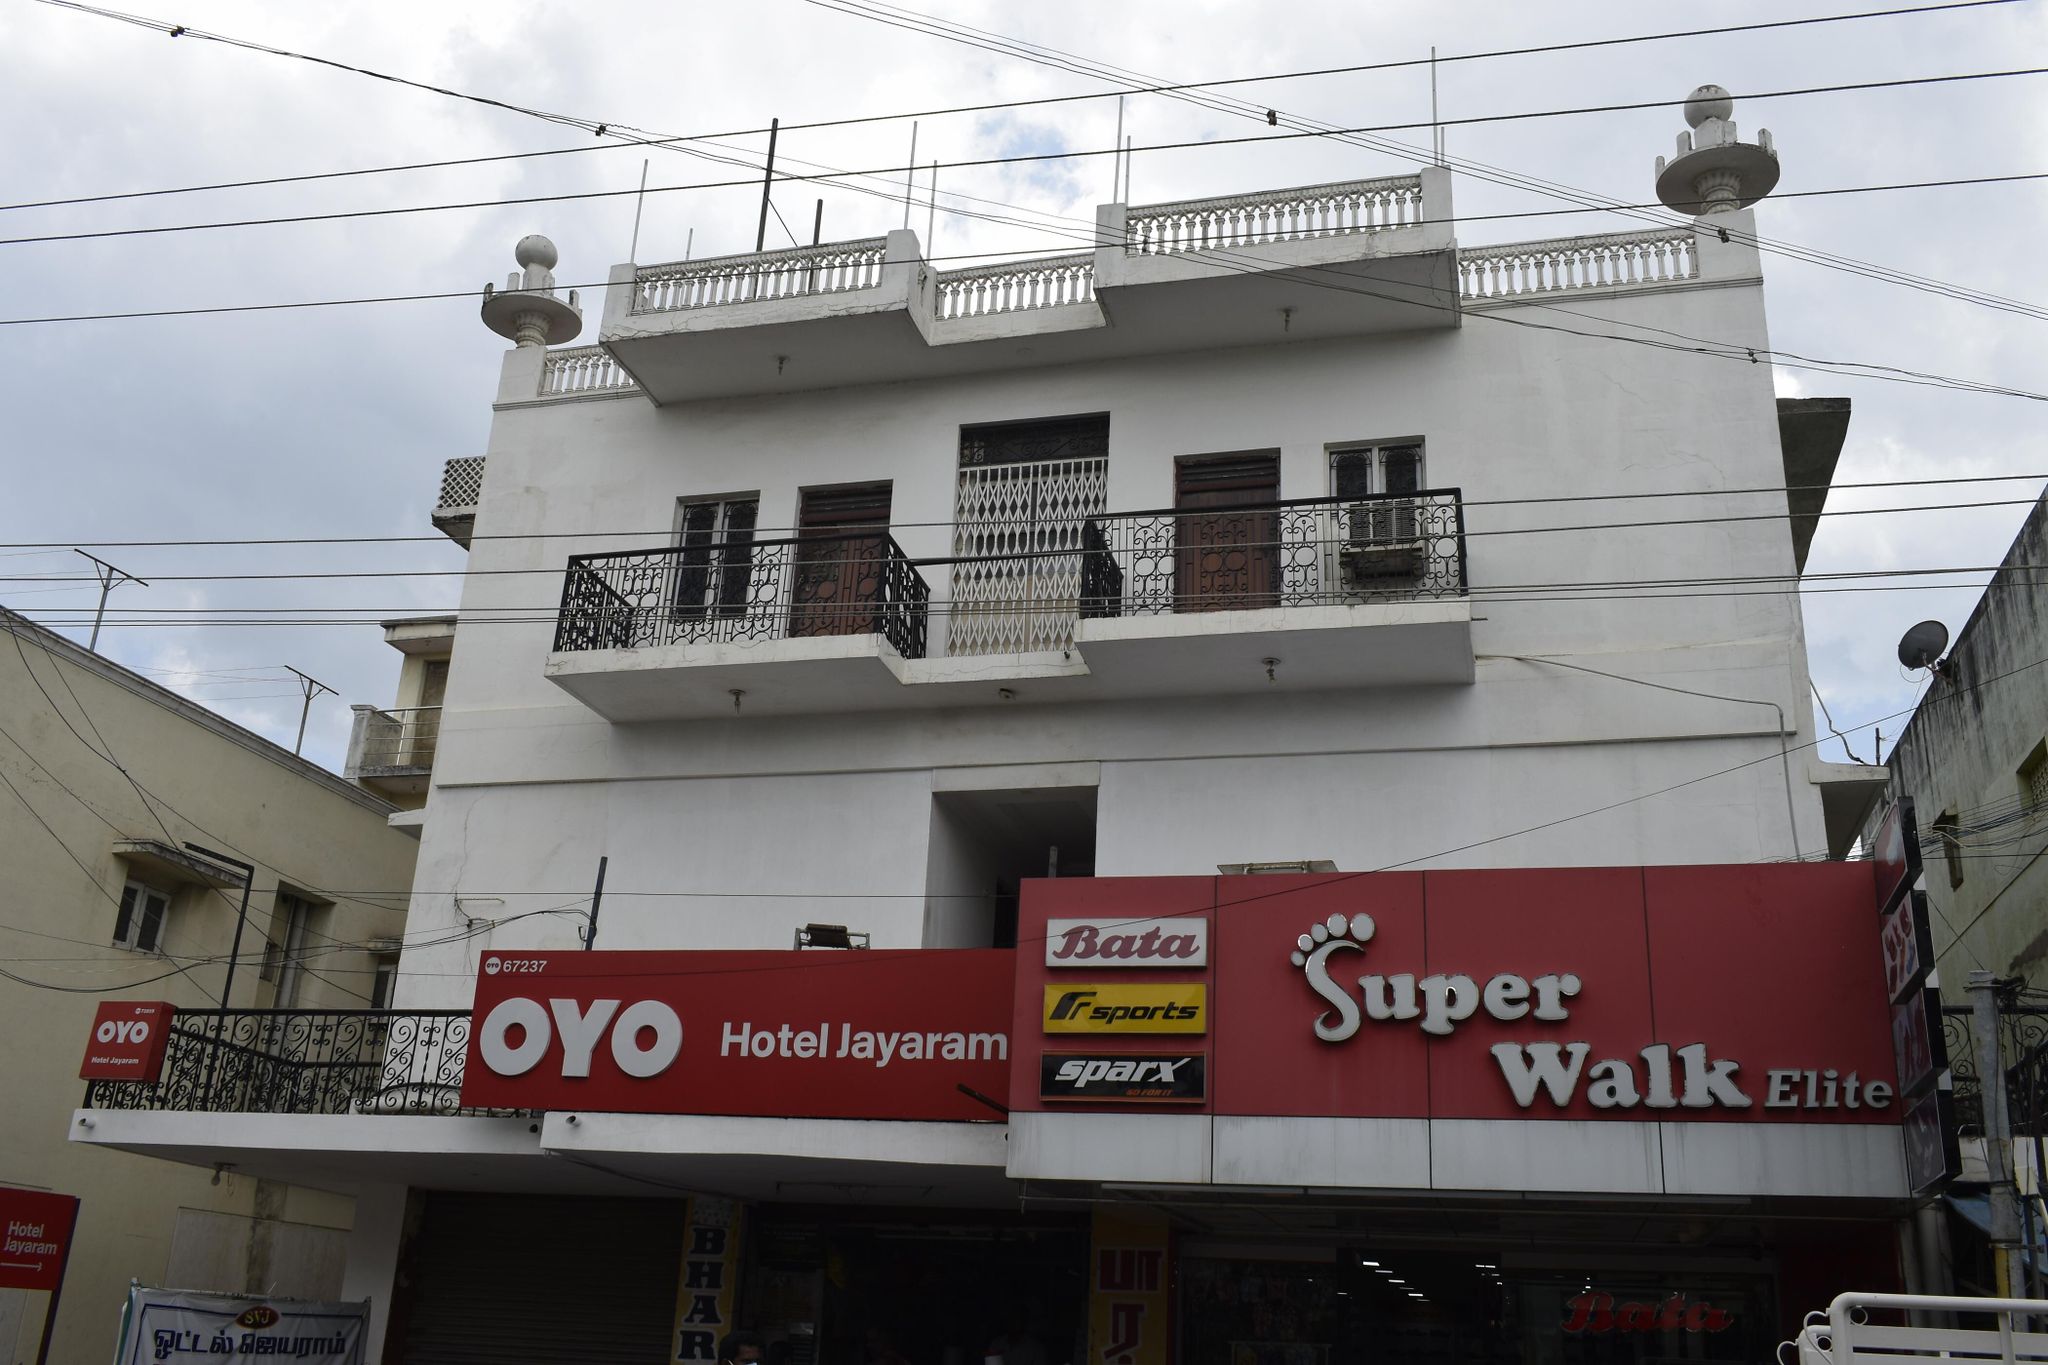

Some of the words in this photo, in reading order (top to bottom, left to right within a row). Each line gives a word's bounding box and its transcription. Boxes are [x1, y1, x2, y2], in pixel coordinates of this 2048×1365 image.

[1052, 924, 1201, 960] Bata
[502, 959, 547, 973] 67237
[1304, 938, 1583, 1042] Super
[96, 1020, 149, 1044] OYO
[480, 997, 683, 1079] OYO
[720, 1021, 830, 1058] Hotel
[836, 1022, 1008, 1068] Jayaram
[91, 1056, 110, 1064] Hotel
[110, 1056, 140, 1066] Jayaram
[1054, 1057, 1192, 1088] sparx
[1490, 1041, 1754, 1109] Walk
[1763, 1068, 1895, 1110] Elite
[7, 1220, 45, 1238] Hotel
[3, 1236, 58, 1256] Jayaram
[244, 1310, 270, 1325] SVJ
[1560, 1290, 1736, 1333] Bata
